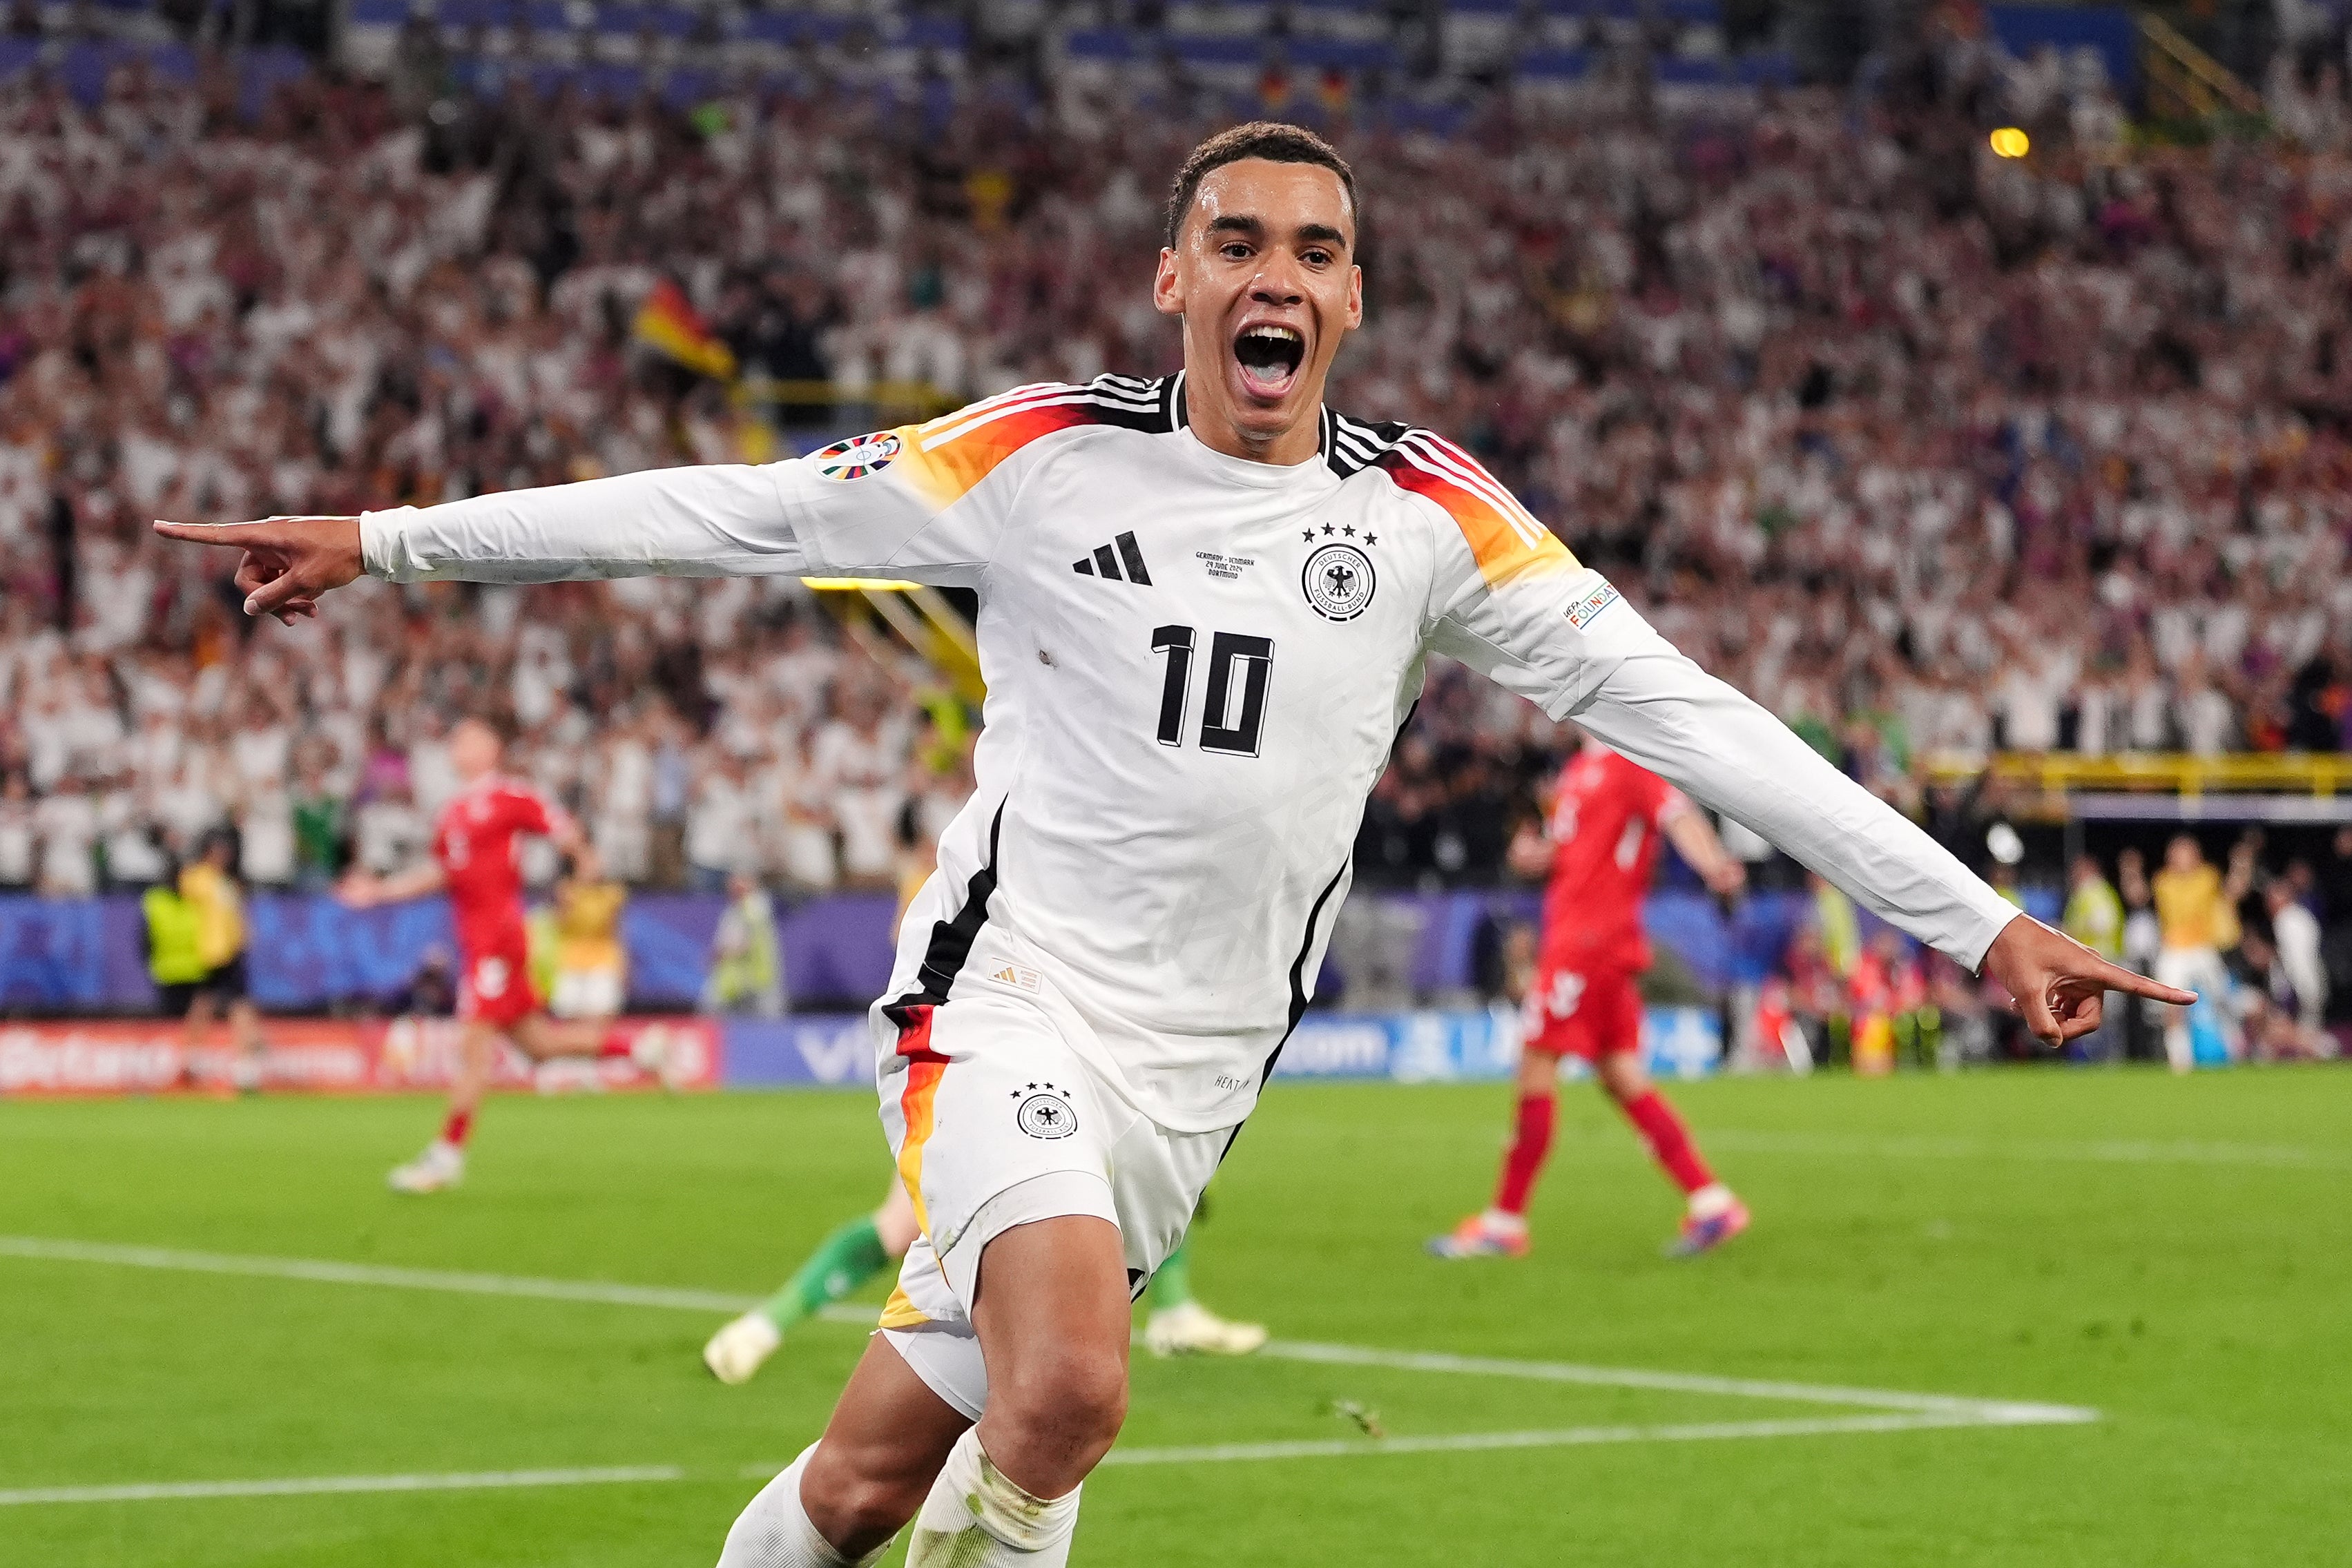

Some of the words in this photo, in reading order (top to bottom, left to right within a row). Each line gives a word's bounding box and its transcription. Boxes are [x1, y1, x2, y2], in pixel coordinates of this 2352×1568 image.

[1196, 552, 1223, 562] GERMANY
[1229, 557, 1255, 566] DENMARK
[1215, 562, 1228, 570] JUNE
[1319, 553, 1361, 568] DEUTSCHER
[1208, 569, 1238, 579] DORTMUND
[1314, 589, 1364, 611] FUSSBALL-BUND
[1563, 601, 1581, 617] UEFA
[1151, 625, 1275, 758] 10
[1215, 1075, 1249, 1092] HEAT
